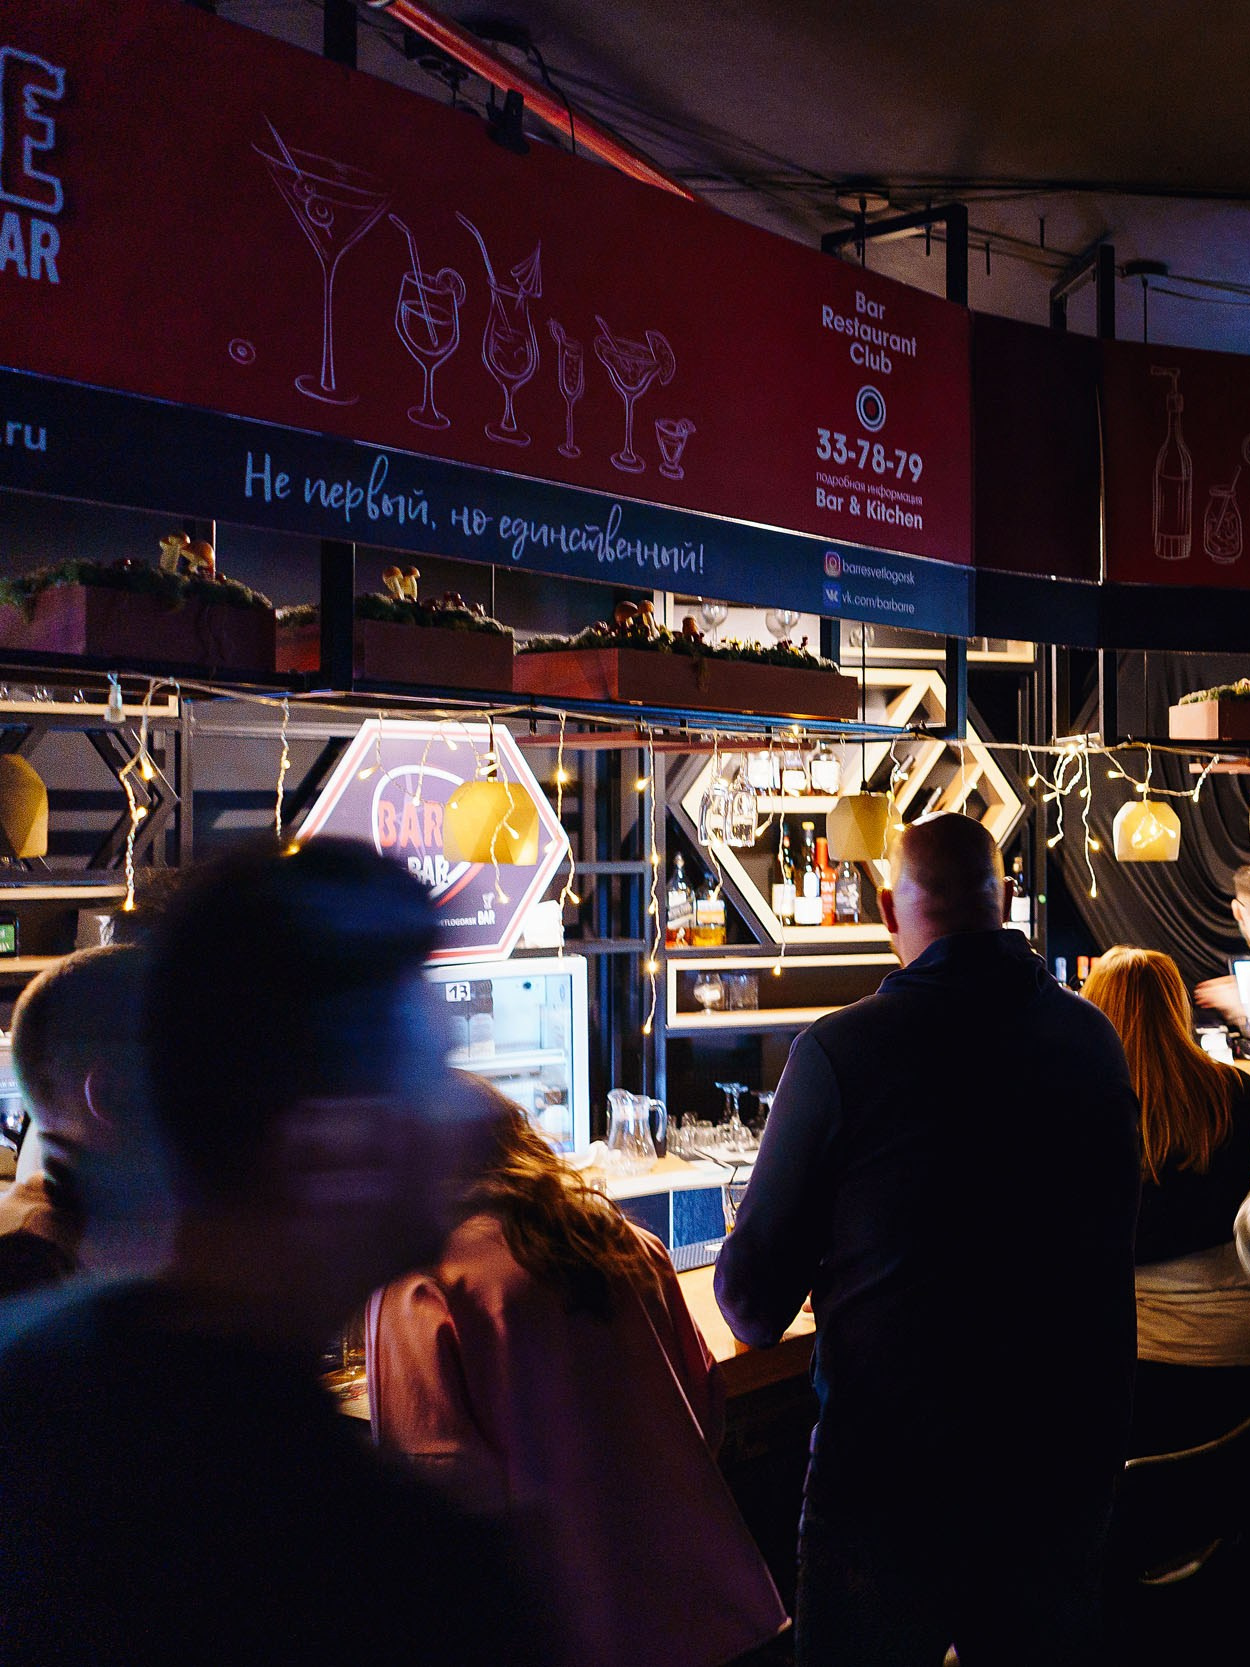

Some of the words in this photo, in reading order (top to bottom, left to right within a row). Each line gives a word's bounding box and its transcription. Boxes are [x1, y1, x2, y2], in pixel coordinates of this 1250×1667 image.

[855, 290, 886, 320] Bar
[822, 304, 917, 358] Restaurant
[850, 342, 893, 375] Club
[816, 427, 924, 484] 33-78-79
[816, 471, 866, 493] подробная
[867, 483, 923, 507] информация
[244, 451, 292, 503] Не
[304, 454, 436, 530] первый,
[451, 506, 491, 536] но
[500, 504, 705, 575] единственный!
[816, 487, 844, 513] Bar
[849, 495, 861, 516] &
[866, 499, 923, 530] Kitchen
[842, 558, 915, 585] barresvetlogorsk
[842, 590, 915, 615] vk.com/barbarre
[377, 799, 444, 849] BAR
[407, 854, 450, 887] BAR
[477, 909, 496, 926] BAR
[448, 983, 469, 999] 13
